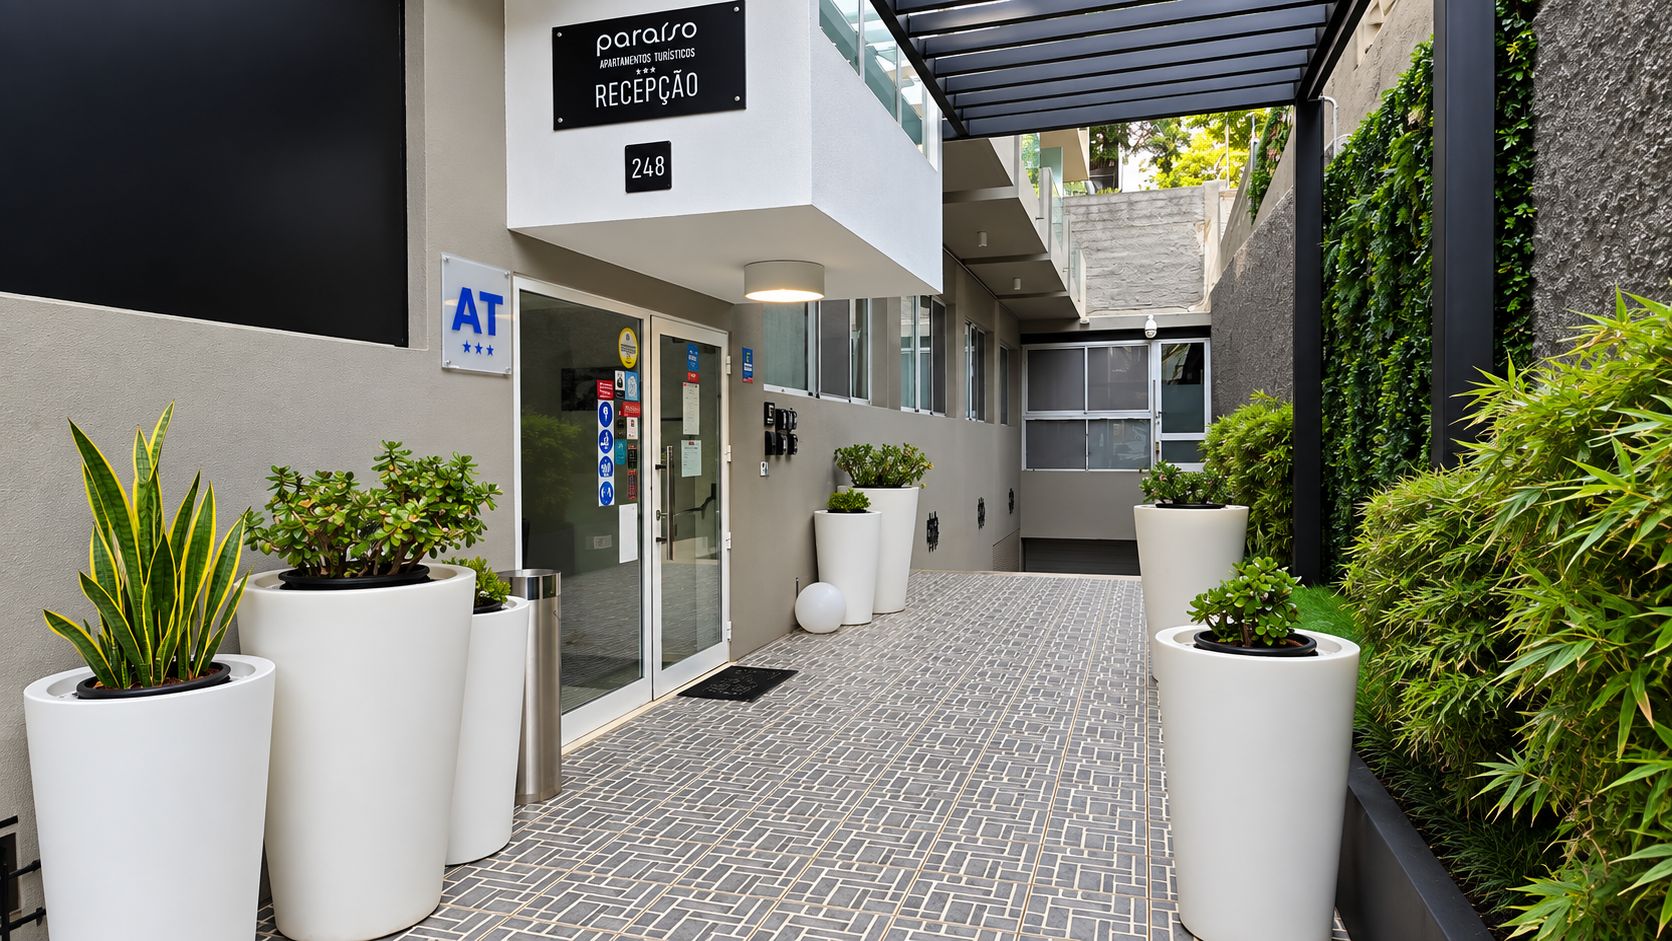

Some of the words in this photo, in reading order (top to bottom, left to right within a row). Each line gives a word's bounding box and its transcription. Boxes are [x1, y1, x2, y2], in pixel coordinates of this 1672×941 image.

[596, 22, 697, 57] paraíso
[600, 54, 651, 69] APARTAMENTOS
[654, 48, 695, 62] TURÍSTICOS
[595, 69, 698, 108] RECEPÇÃO
[632, 156, 664, 178] 248
[452, 287, 503, 336] AT
